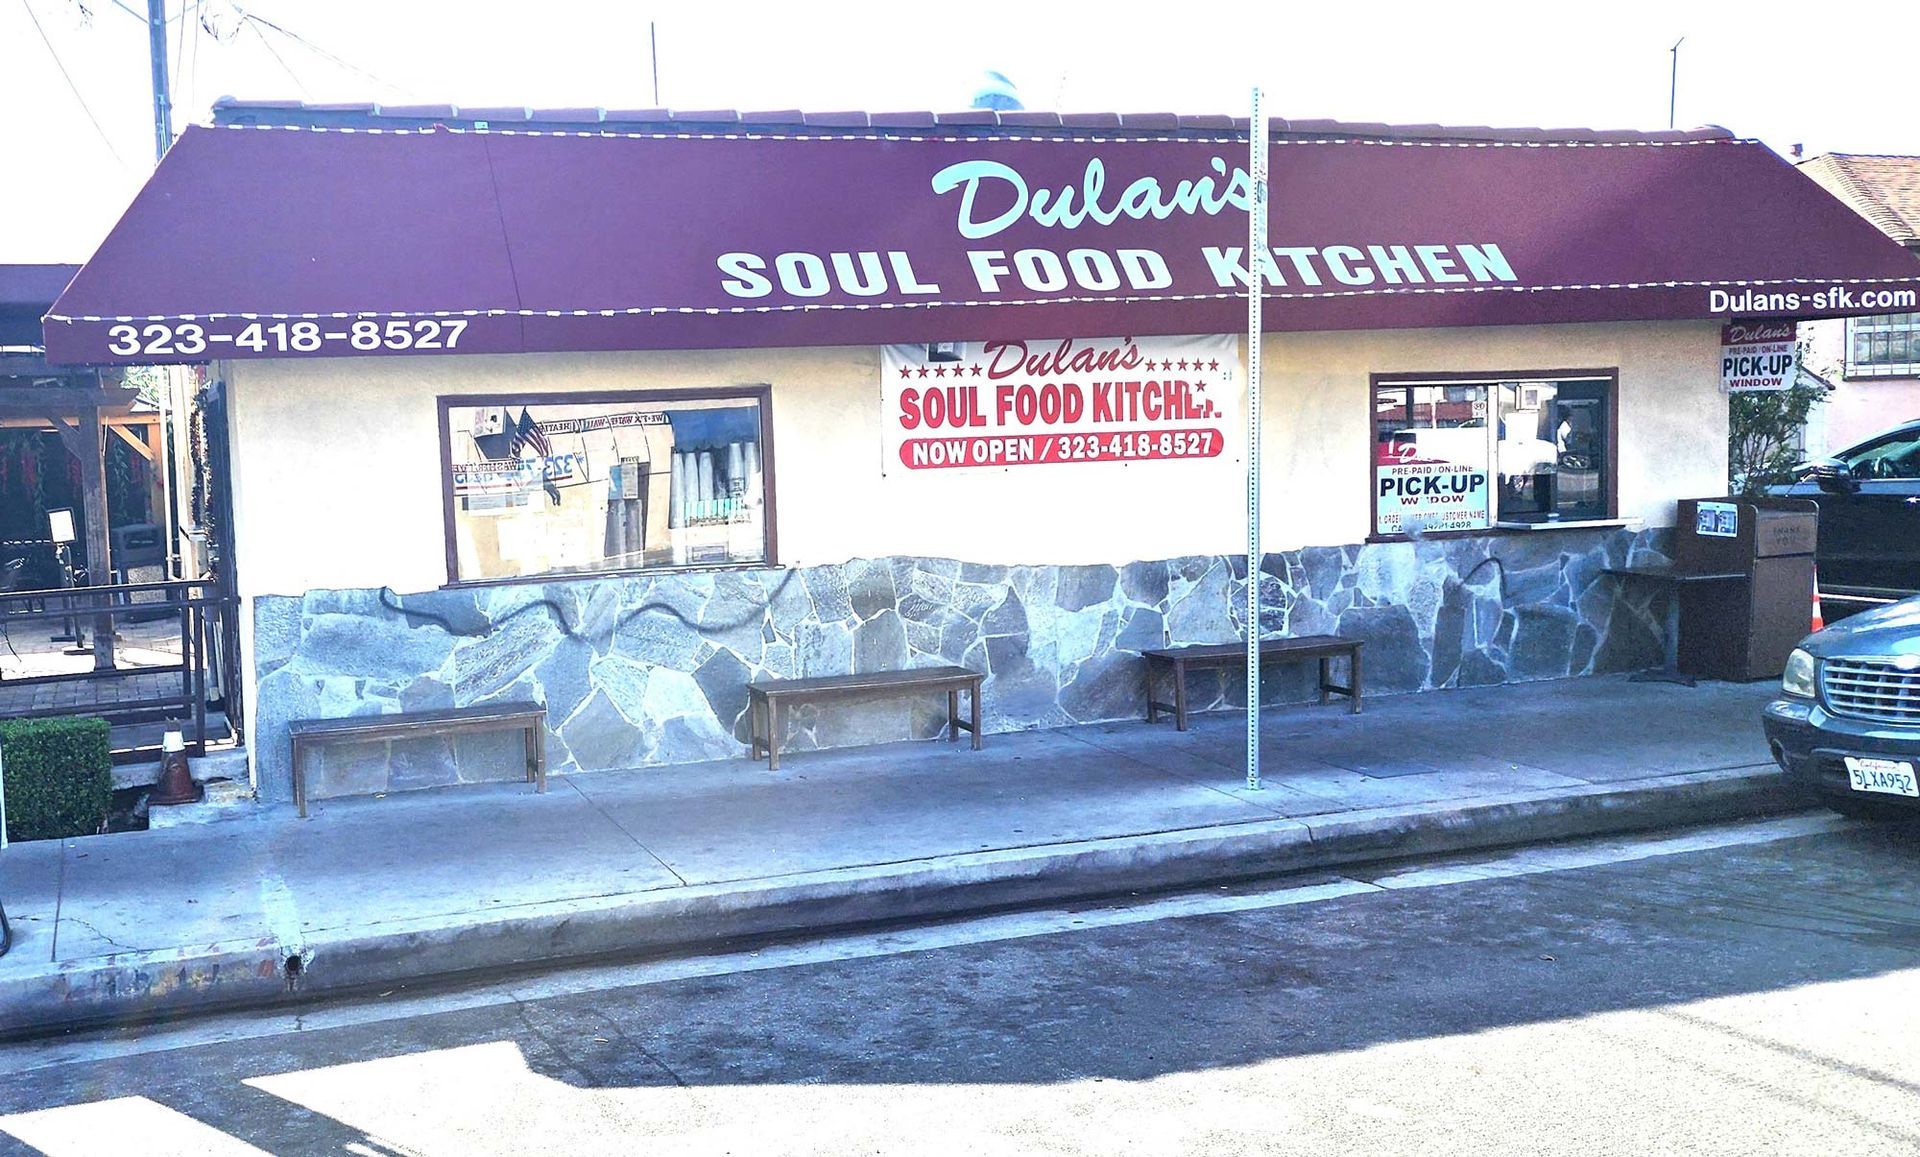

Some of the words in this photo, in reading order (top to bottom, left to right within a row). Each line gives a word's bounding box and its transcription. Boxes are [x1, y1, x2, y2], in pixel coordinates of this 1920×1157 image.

[931, 157, 1253, 239] Dulan's
[719, 251, 941, 299] SOUL
[971, 248, 1173, 294] FOOD
[1709, 287, 1916, 313] Dulans-sfk.com
[108, 319, 468, 356] 323-418-8527
[1729, 323, 1791, 343] Dulan's
[983, 336, 1144, 380] Dulan's
[1723, 355, 1793, 377] PICK-UP
[1729, 377, 1782, 387] WINDOW
[899, 385, 987, 430] SOUL
[996, 383, 1084, 426] FOOD
[1092, 379, 1222, 424] KITCH
[912, 439, 968, 466] NOW
[972, 437, 1035, 464] OPEN
[1058, 432, 1213, 460] 323-418-8527
[1392, 466, 1432, 475] PRE-PAID
[1438, 465, 1473, 473] ON-LINE
[1380, 474, 1485, 496] PICK-UP
[1400, 495, 1464, 505] WDOW
[1440, 512, 1468, 522] USTOMER
[1853, 769, 1914, 792] 5LXA952
